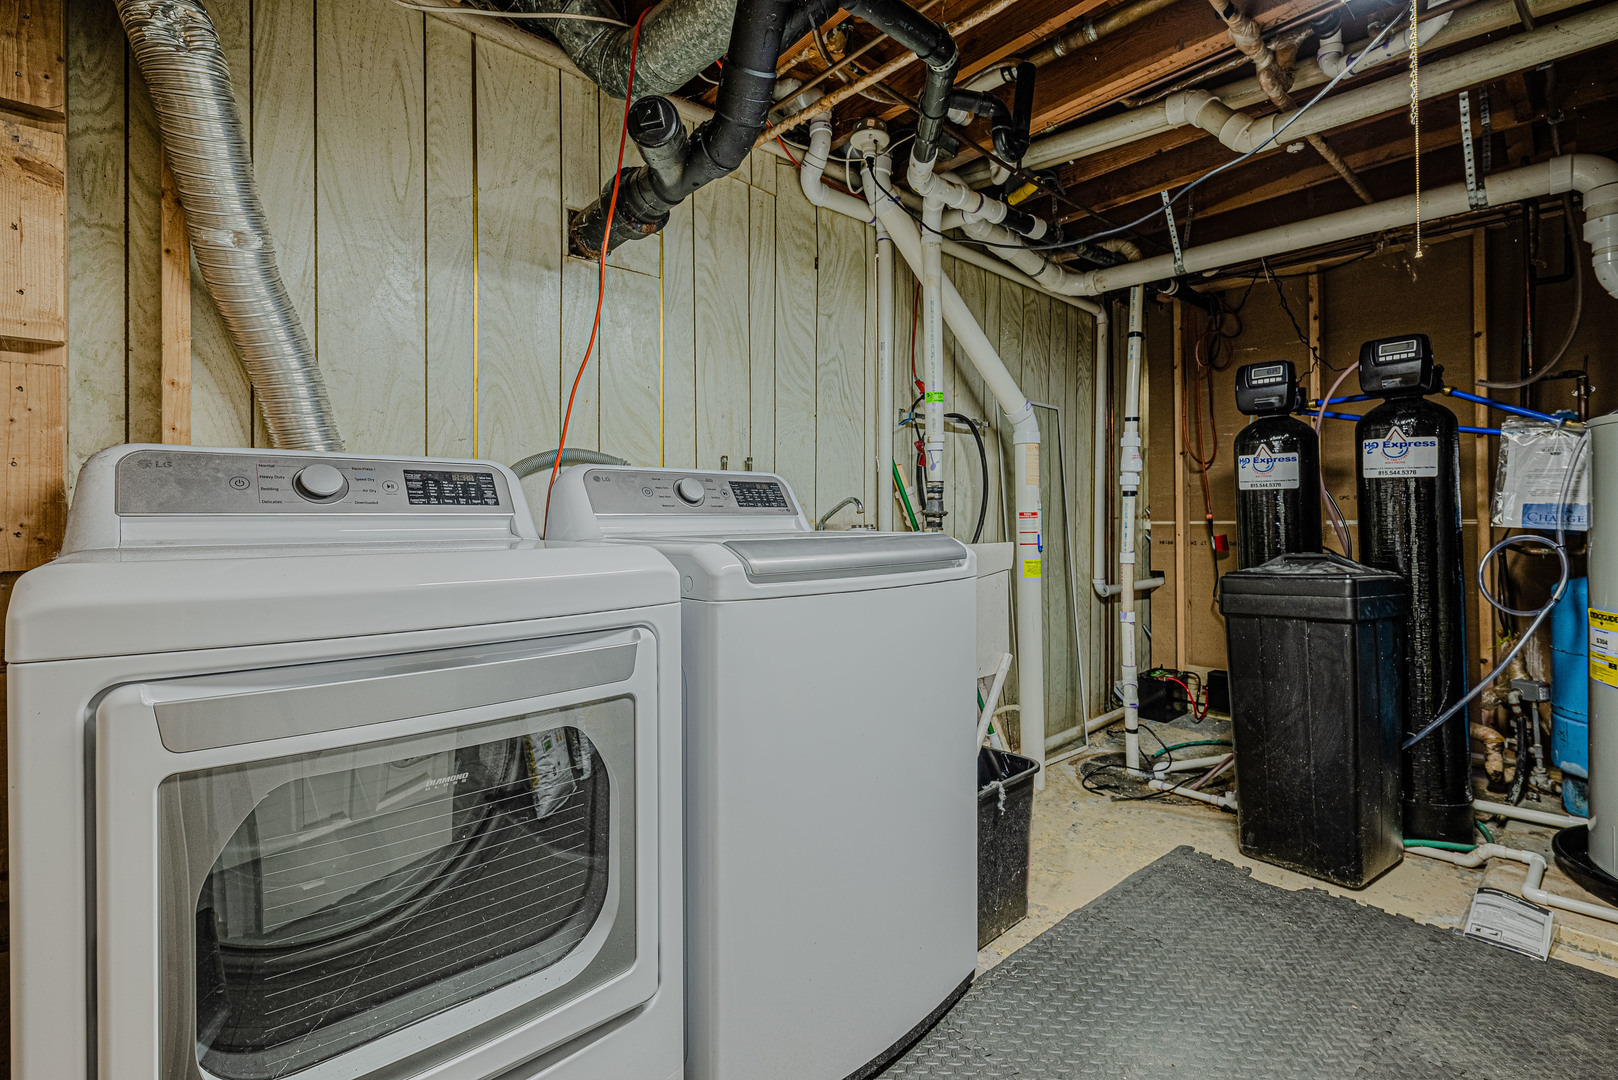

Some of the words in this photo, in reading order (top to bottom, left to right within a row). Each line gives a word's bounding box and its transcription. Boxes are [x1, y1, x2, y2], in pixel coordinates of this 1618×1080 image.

[1382, 440, 1436, 449] Express
[155, 460, 172, 468] LG
[1253, 456, 1297, 464] Express
[1526, 511, 1585, 523] CHAGE
[425, 772, 469, 787] DIAMOND
